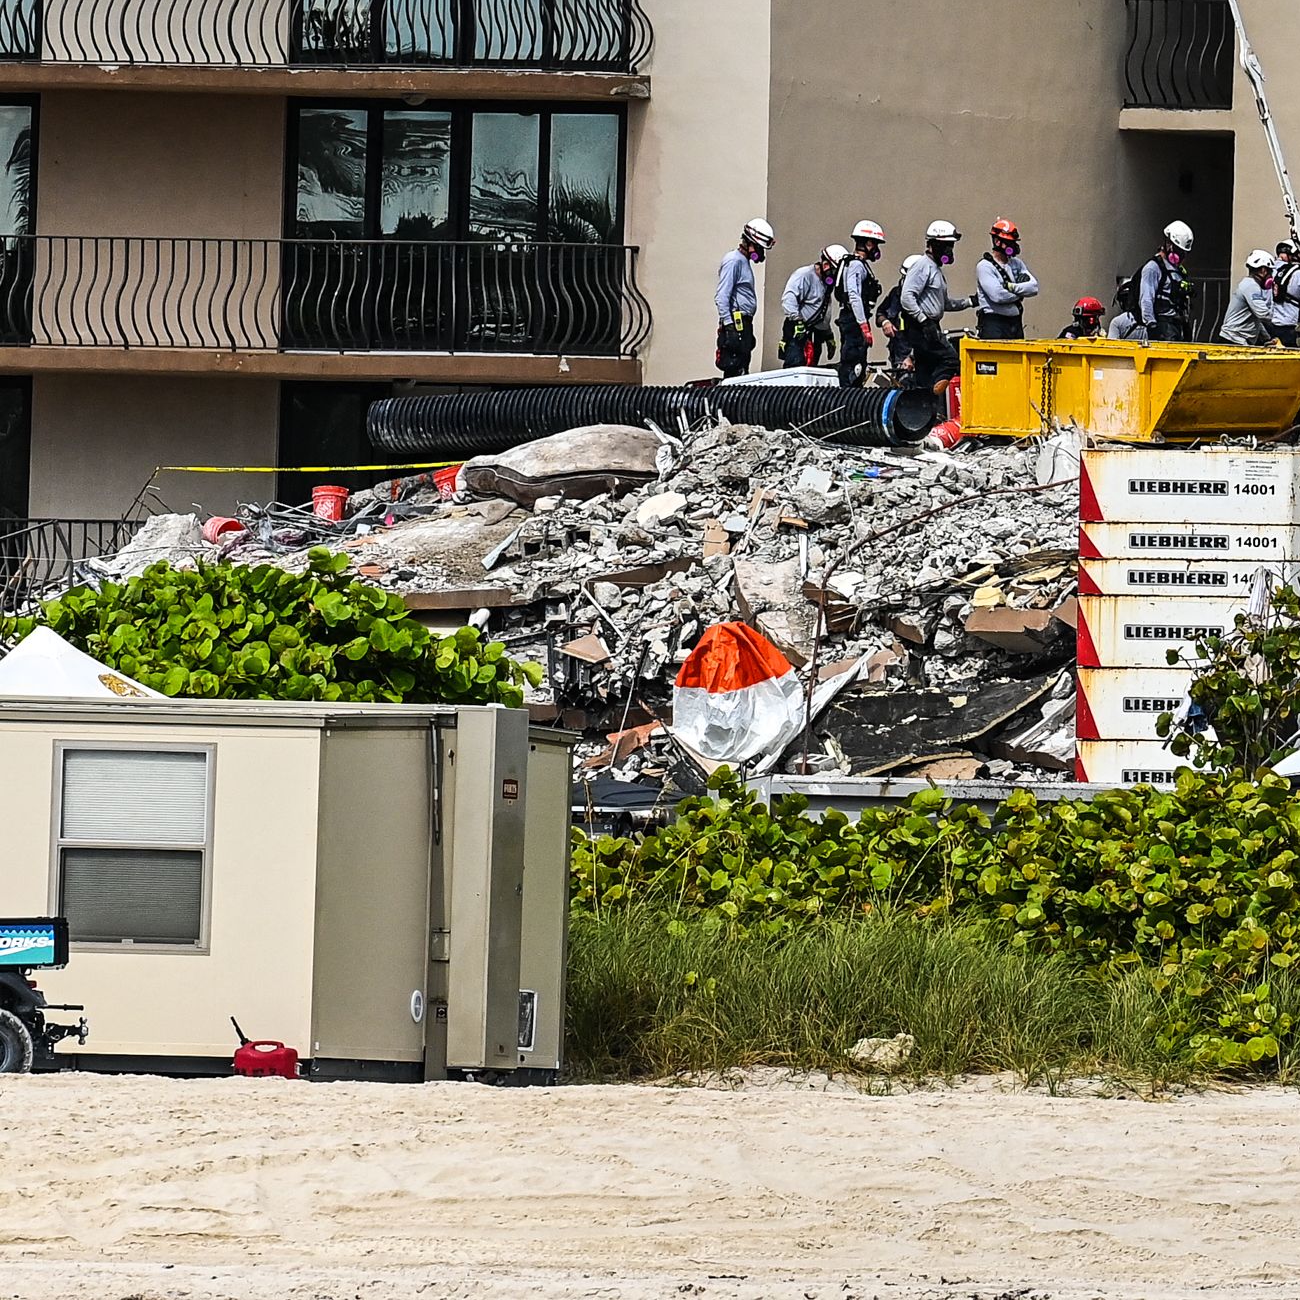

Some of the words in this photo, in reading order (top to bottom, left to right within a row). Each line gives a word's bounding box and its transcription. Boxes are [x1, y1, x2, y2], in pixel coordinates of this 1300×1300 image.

[1130, 481, 1227, 494] LIEBHERR
[1233, 484, 1276, 496] 14001
[1130, 535, 1227, 548] LIEBHERR
[1235, 537, 1278, 548] 14001
[1129, 572, 1226, 585] LIEBHERR
